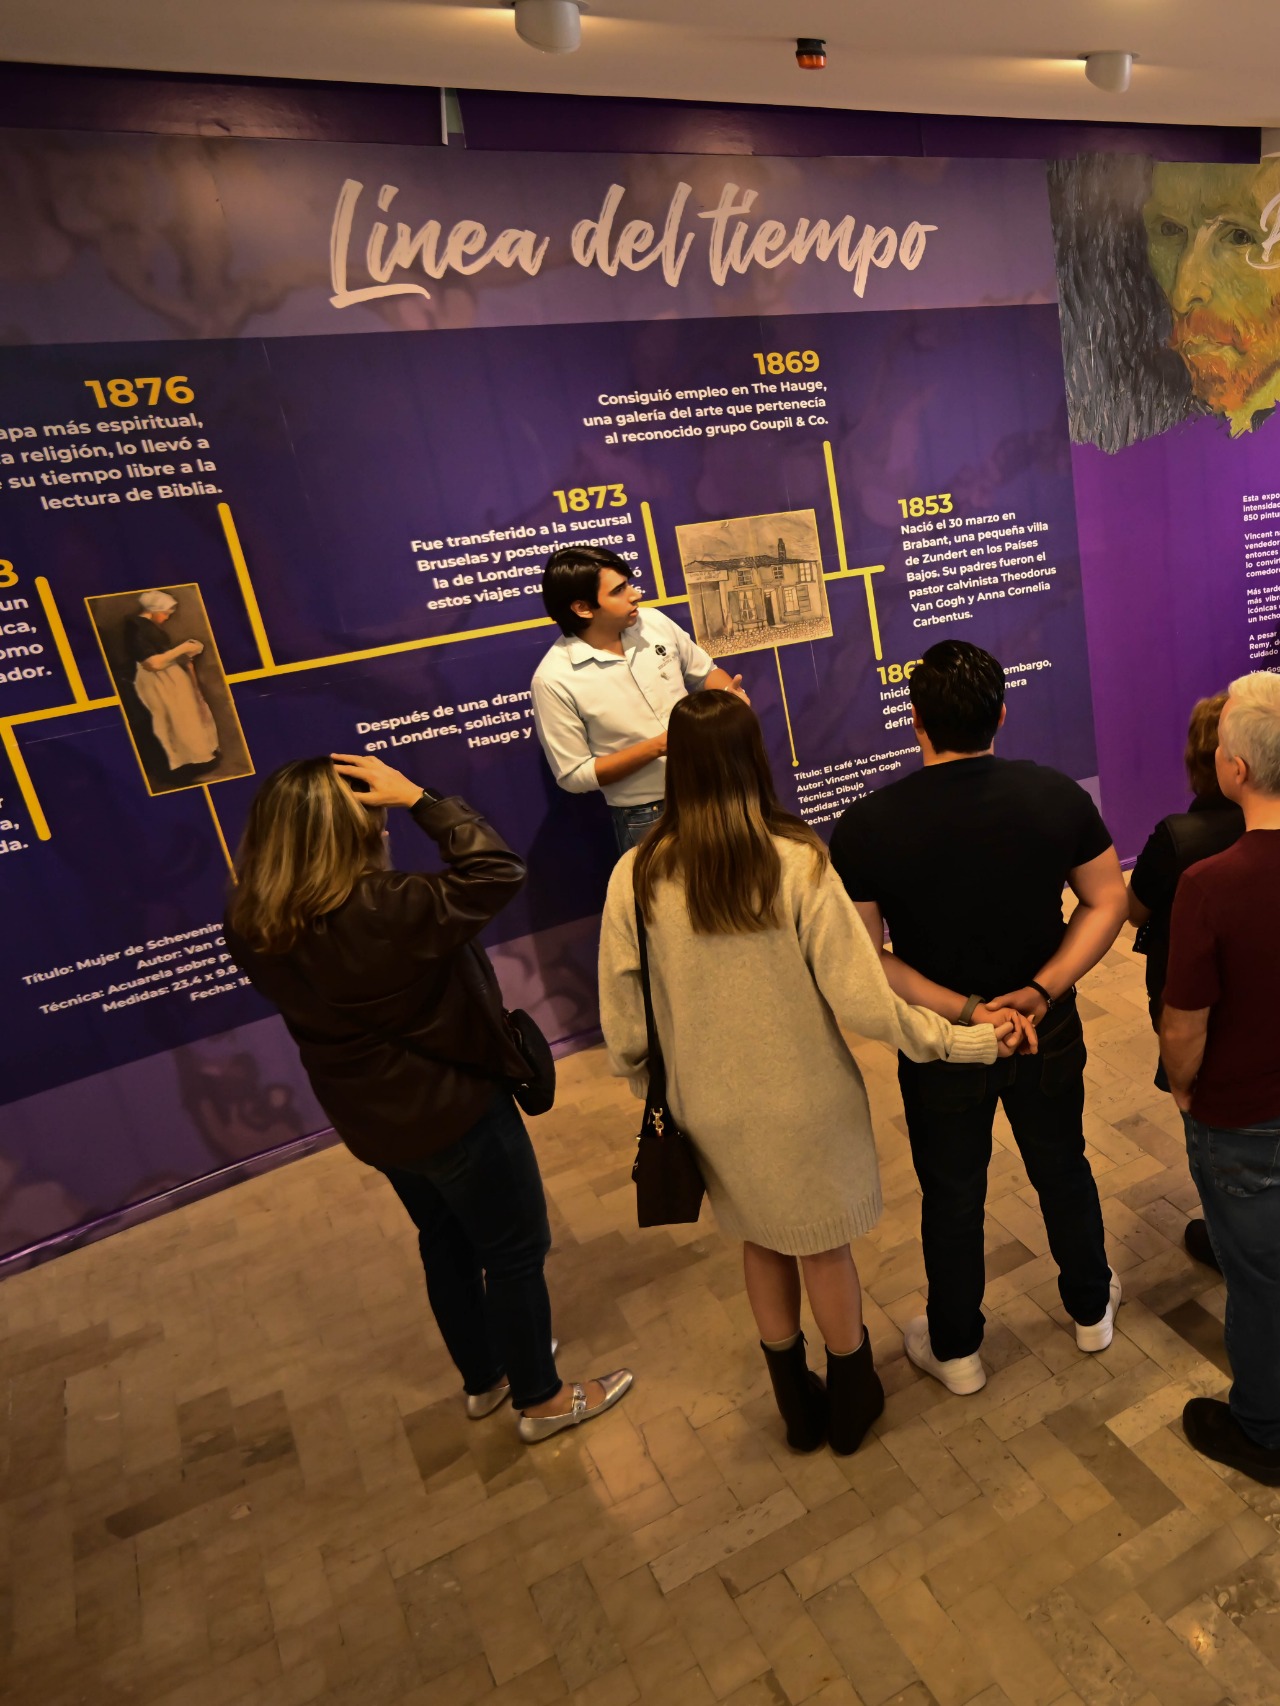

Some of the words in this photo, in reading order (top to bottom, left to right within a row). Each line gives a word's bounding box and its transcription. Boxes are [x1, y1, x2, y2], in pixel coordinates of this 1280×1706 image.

[571, 182, 695, 287] del
[697, 182, 938, 298] tiempo
[753, 350, 819, 374] 1869
[84, 376, 194, 408] 1876
[598, 389, 672, 405] Consiguió
[675, 386, 728, 400] empleo
[732, 386, 749, 396] en
[751, 383, 777, 393] The
[780, 381, 827, 392] Hauge,
[43, 420, 91, 436] más
[97, 413, 203, 434] espiritual,
[583, 416, 612, 426] una
[616, 409, 666, 426] galería
[670, 407, 692, 419] del
[695, 406, 723, 417] arte
[727, 405, 752, 416] que
[756, 397, 826, 414] pertenecía
[605, 432, 618, 444] al
[622, 425, 702, 442] reconocido
[706, 423, 747, 437] grupo
[750, 417, 793, 431] Goupil
[796, 417, 805, 426] &
[808, 415, 828, 425] Co.
[21, 444, 114, 463] religión,
[116, 442, 137, 455] lo
[141, 437, 192, 453] llevó
[197, 439, 210, 448] a
[8, 477, 36, 488] su
[41, 469, 122, 485] tiempo
[126, 464, 175, 478] libre
[180, 463, 193, 473] a
[197, 459, 216, 472] la
[41, 493, 120, 510] lectura
[126, 488, 153, 501] de
[157, 481, 223, 498] Biblia.
[553, 484, 627, 513] 1873
[898, 493, 953, 518] 1853
[411, 540, 443, 552] Fue
[446, 526, 536, 547] transferido
[540, 526, 549, 535] a
[552, 522, 566, 533] la
[570, 513, 632, 531] sucursal
[901, 521, 933, 534] Nació
[936, 519, 946, 529] el
[949, 518, 962, 528] 30
[966, 515, 999, 525] marzo
[903, 536, 951, 550] Brabant,
[954, 534, 975, 543] una
[978, 525, 1025, 542] pequeña
[1027, 522, 1048, 532] villa
[417, 553, 489, 571] Bruselas
[491, 552, 501, 563] y
[627, 534, 635, 542] a
[905, 556, 919, 566] de
[922, 549, 968, 563] Zundert
[970, 548, 984, 556] en
[987, 545, 1002, 554] los
[1005, 540, 1038, 551] Países
[907, 570, 940, 582] Bajos.
[942, 567, 956, 576] Su
[960, 561, 997, 575] padres
[999, 556, 1034, 567] fueron
[1037, 552, 1046, 561] el
[433, 578, 449, 589] la
[452, 574, 474, 586] de
[477, 565, 545, 582] Londres.
[909, 585, 944, 599] pastor
[947, 576, 998, 590] calvinista
[1001, 567, 1056, 582] Theodorus
[427, 595, 471, 610] estos
[474, 587, 521, 602] viajes
[911, 603, 933, 612] Van
[936, 596, 965, 608] Gogh
[968, 594, 975, 604] y
[977, 591, 1005, 601] Anna
[1008, 581, 1050, 596] Cornelia
[913, 611, 973, 627] Carbentus.
[1003, 660, 1051, 675] embargo,
[880, 686, 910, 700] Inició
[356, 711, 430, 734] Después
[433, 706, 454, 717] de
[457, 700, 488, 712] una
[365, 741, 387, 751] en
[391, 725, 462, 746] Londres,
[464, 712, 521, 730] solicita
[468, 730, 519, 748] Hauge
[522, 727, 531, 739] y
[794, 769, 822, 780] Título:
[824, 765, 832, 773] El
[834, 760, 852, 770] café
[870, 746, 921, 762] Charbonnag
[797, 781, 824, 792] Autor:
[825, 772, 859, 784] Vincent
[861, 768, 877, 776] Van
[879, 761, 901, 771] Gogh
[798, 790, 834, 803] Técnica:
[836, 782, 864, 794] Dibujo
[801, 800, 840, 815] Medidas:
[22, 966, 74, 985] Título:
[76, 952, 120, 970] Mujer
[124, 946, 144, 956] de
[146, 923, 224, 950] Schevenin
[137, 951, 182, 969] Autor:
[183, 942, 212, 955] Van
[39, 990, 104, 1014] Técnica:
[108, 970, 173, 994] Acuarela
[175, 955, 216, 974] sobre
[102, 982, 170, 1012] Medidas:
[171, 976, 202, 991] 23.4
[215, 965, 238, 977] 9.8
[190, 982, 237, 1001] Fecha:
